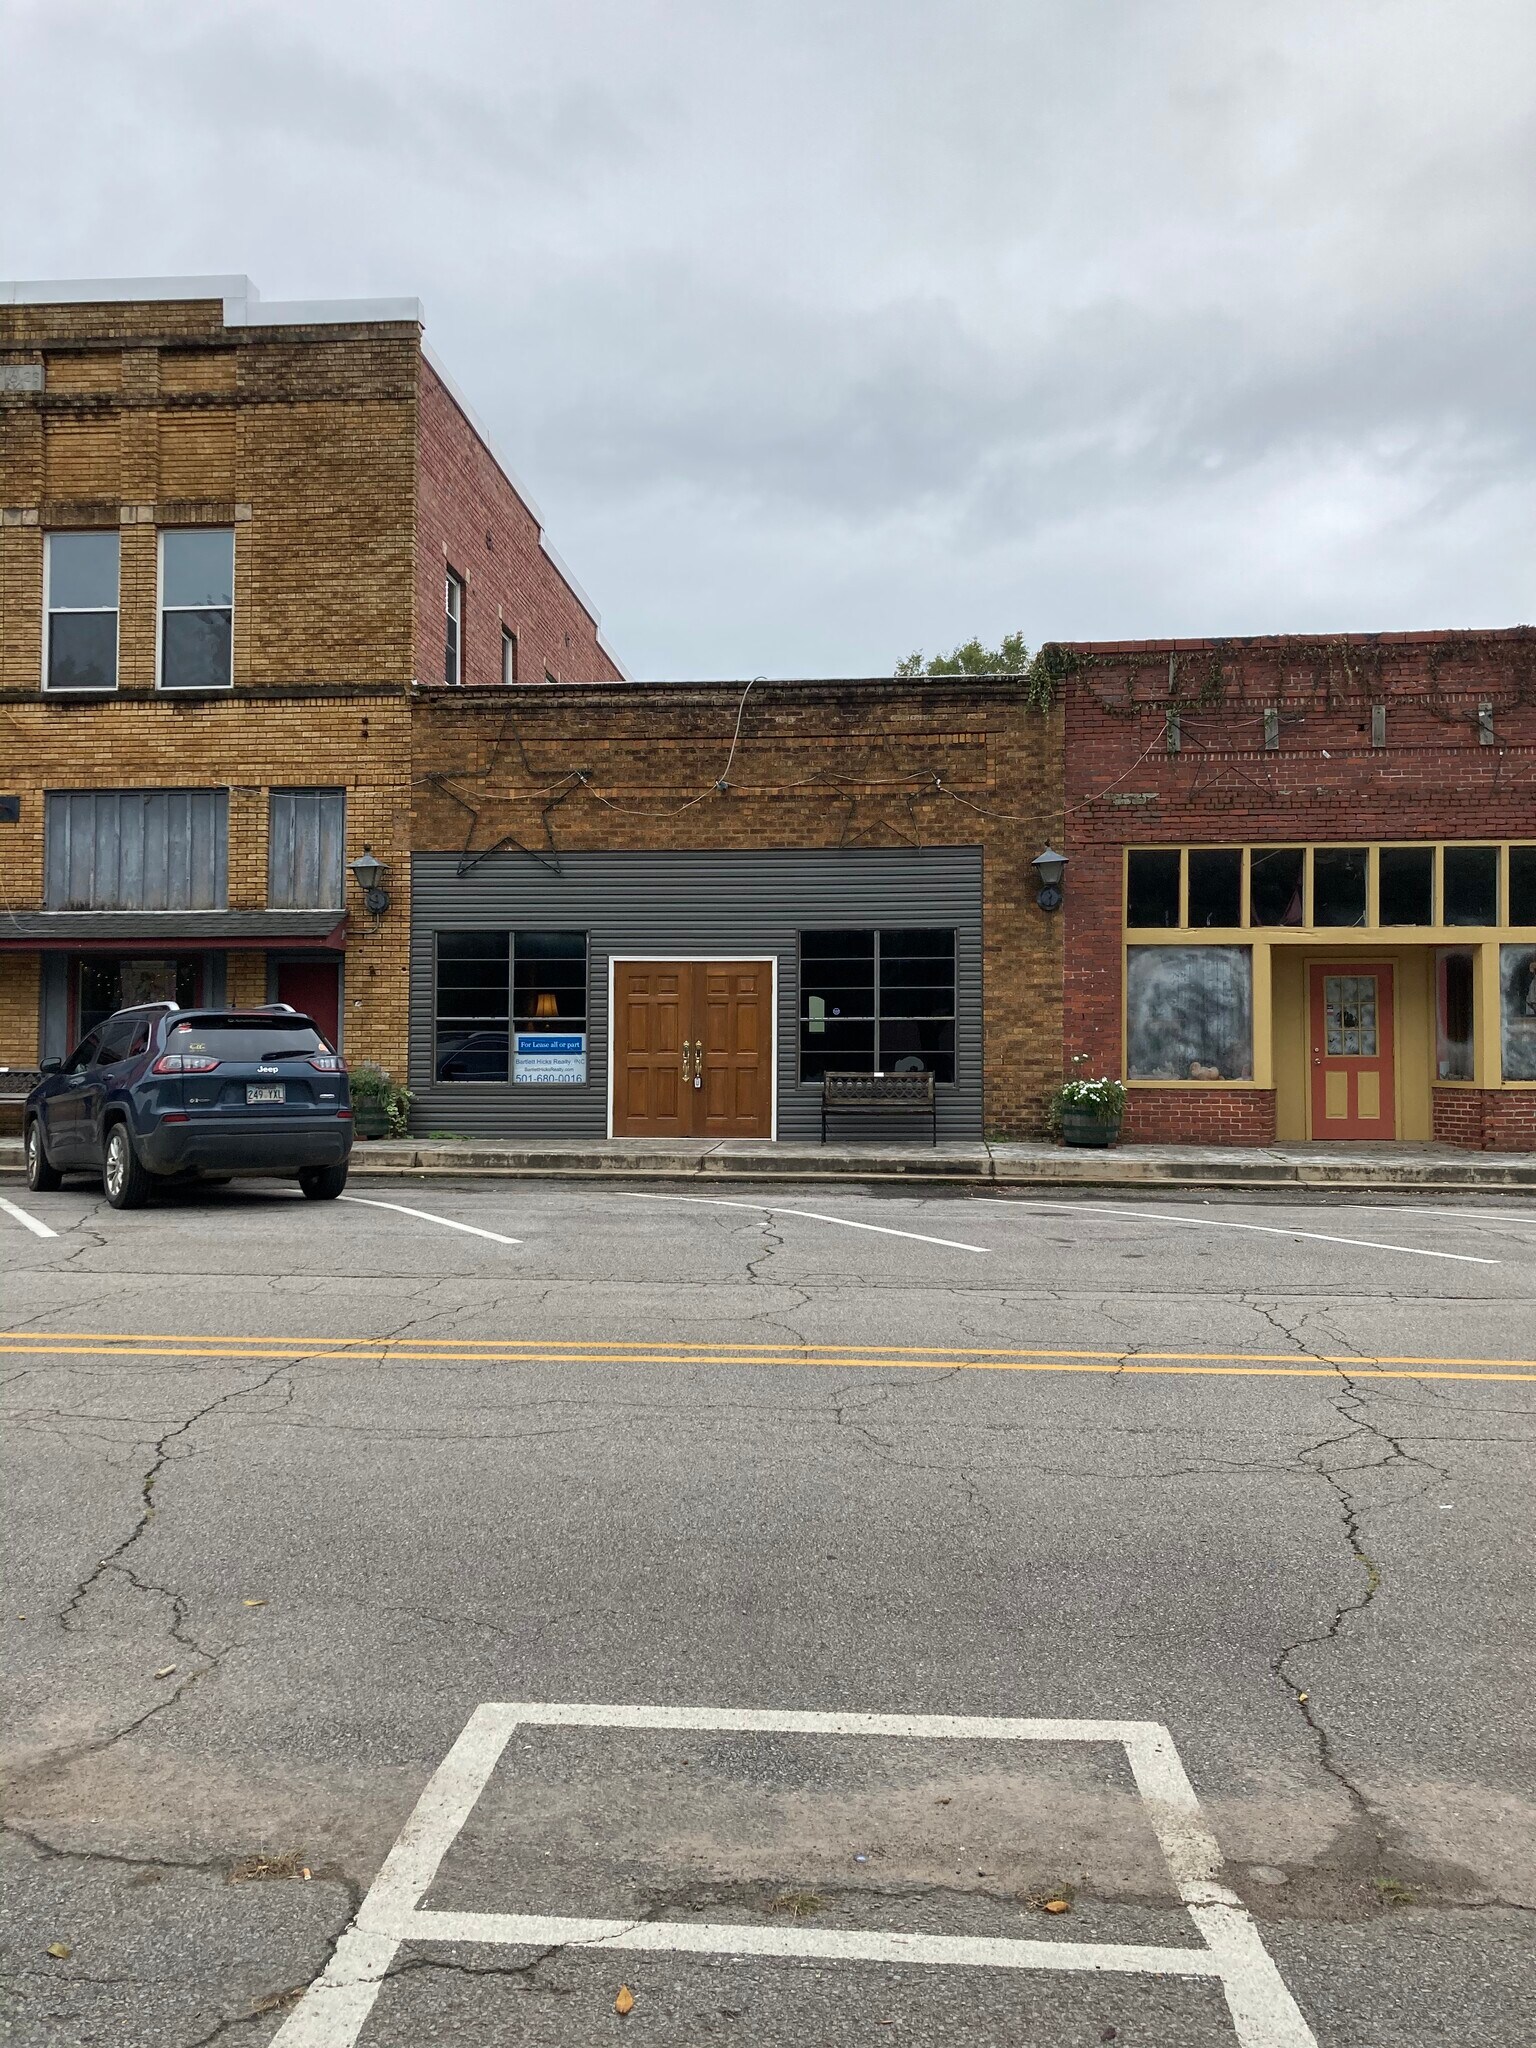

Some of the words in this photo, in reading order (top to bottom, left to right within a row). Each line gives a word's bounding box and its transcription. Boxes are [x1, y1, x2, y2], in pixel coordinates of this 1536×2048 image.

[257, 1065, 279, 1074] Jeep
[515, 1074, 582, 1082] 501-680-0016
[247, 1089, 263, 1099] 249
[268, 1089, 284, 1099] YXL
